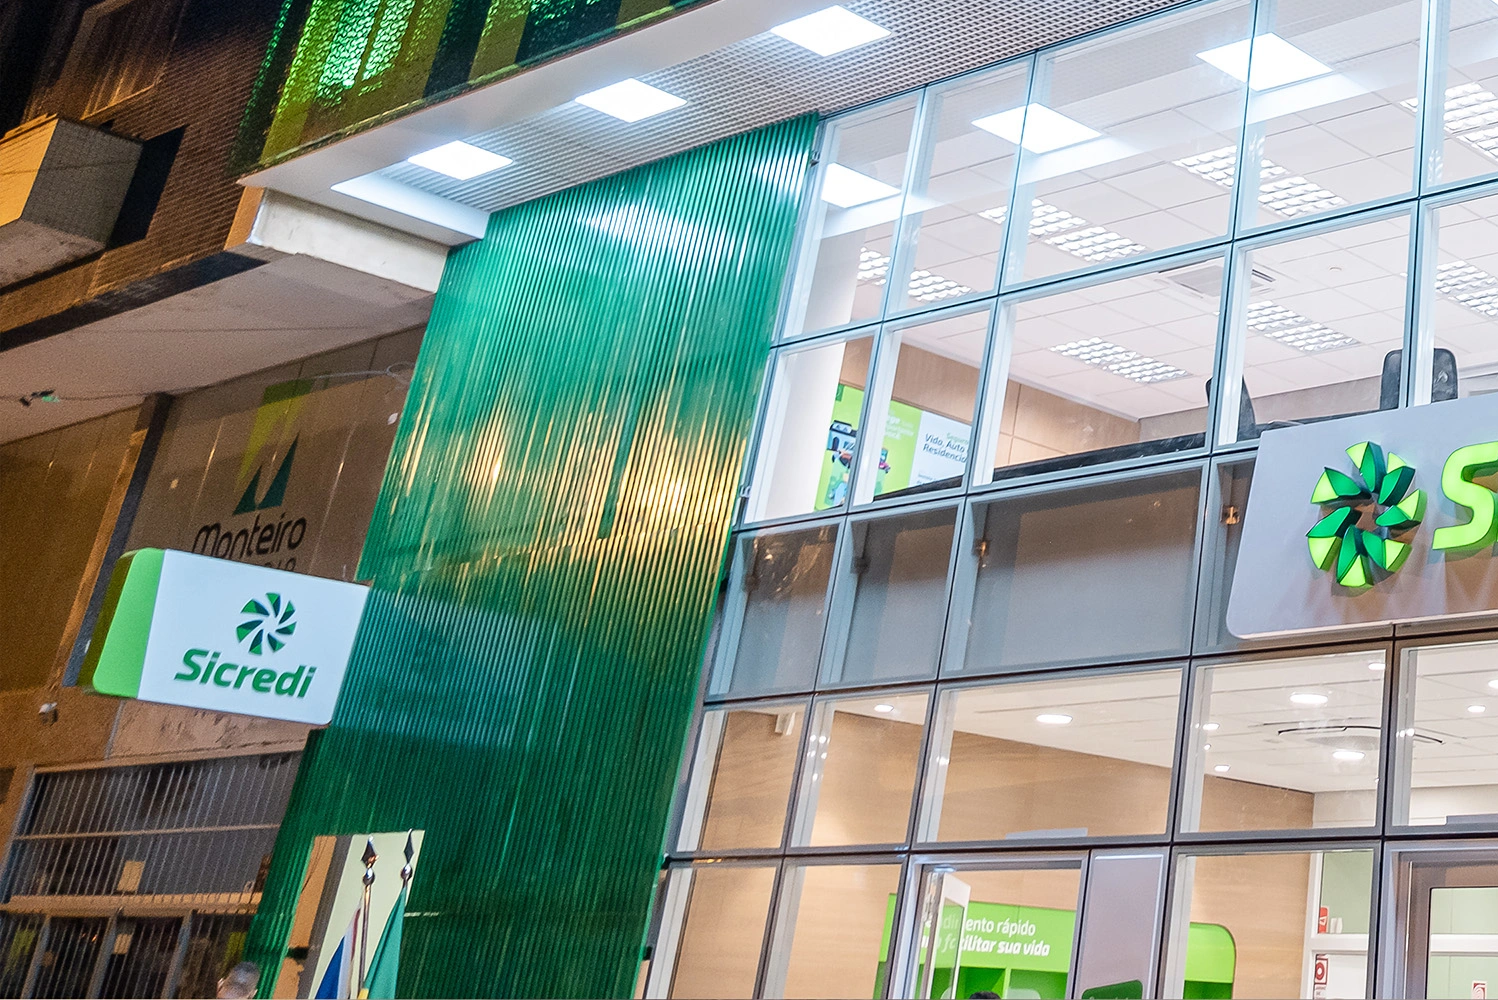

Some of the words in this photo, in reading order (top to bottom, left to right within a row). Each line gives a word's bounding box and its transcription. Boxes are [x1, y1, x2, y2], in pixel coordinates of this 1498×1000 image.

[923, 443, 967, 463] Residencia
[174, 648, 317, 698] Sicredi
[996, 918, 1036, 938] rápido
[997, 942, 1020, 954] sua
[1023, 939, 1050, 957] vida
